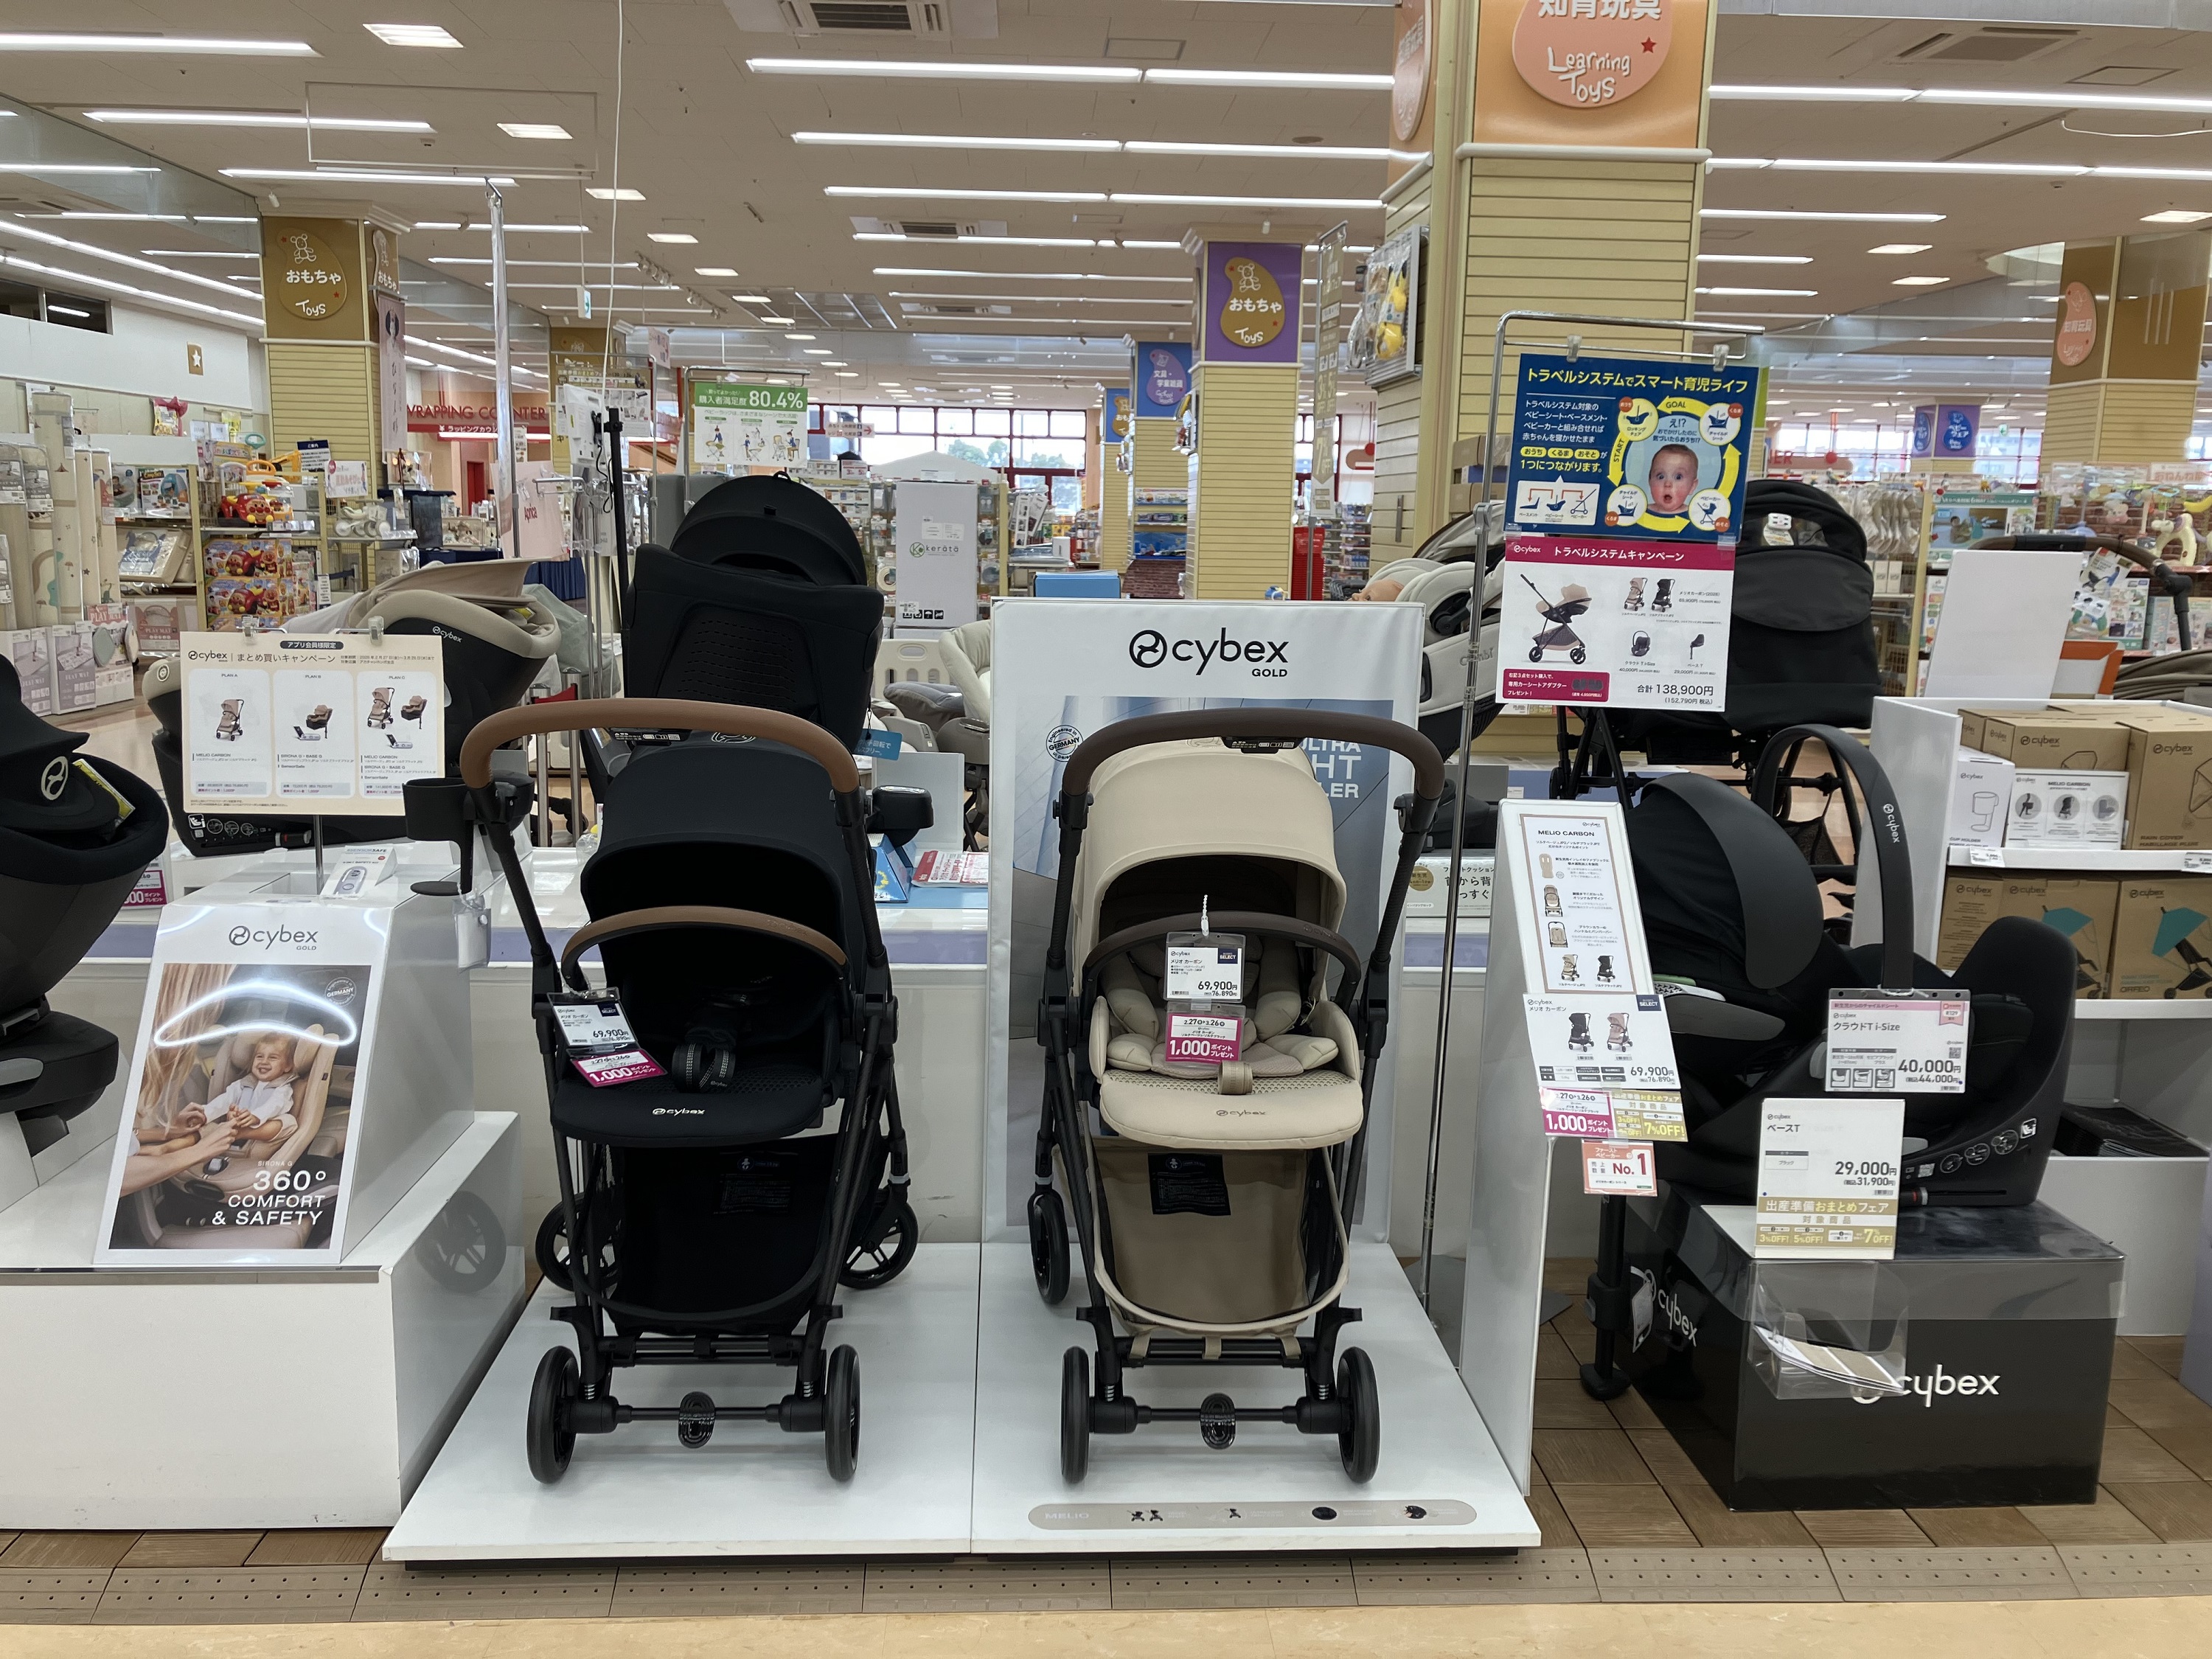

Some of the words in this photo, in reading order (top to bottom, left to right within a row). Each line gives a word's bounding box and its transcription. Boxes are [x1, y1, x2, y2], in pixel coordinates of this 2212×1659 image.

[1548, 47, 1630, 75] Learning
[1559, 69, 1615, 102] Toys
[286, 270, 341, 285] おもちゃ
[378, 270, 397, 291] おもちゃ
[296, 299, 326, 316] Toys
[1229, 297, 1281, 313] おもちゃ
[1234, 327, 1264, 344] Toys
[1528, 368, 1748, 393] トラベルシステムでスマート育児ライフ
[749, 390, 804, 408] 80.4%
[1525, 400, 1599, 411] トラベルシステム対象の
[479, 406, 546, 420] CONTER
[1523, 422, 1604, 433] ベビーカーと組み合せれば
[1669, 418, 1686, 428] え!?
[1523, 432, 1595, 443] 赤ちゃんを寝かせたまま
[1614, 439, 1624, 462] START
[1521, 459, 1603, 473] 1つにつながります。
[1521, 546, 1541, 554] cybex
[1554, 546, 1685, 562] トラベルシステムキャンペーン
[90, 611, 107, 622] PLAY
[440, 629, 462, 642] cybex
[199, 650, 228, 661] cybex
[237, 654, 335, 663] まとめ買いキャンペーン
[1172, 627, 1289, 675] cybex
[1251, 668, 1288, 677] GOLD
[1638, 685, 1653, 694] 合計
[1656, 684, 1714, 696] 138,900円
[1049, 737, 1079, 751] GERMANY
[2032, 735, 2060, 746] cybex
[2164, 743, 2194, 755] cybex
[1885, 814, 1900, 843] cybex
[1966, 885, 1992, 895] cybex
[2020, 886, 2046, 896] cybex
[2140, 888, 2165, 899] cybex
[253, 925, 319, 950] cybex
[327, 987, 353, 997] GERMANY
[1197, 981, 1237, 990] 69,900円
[1834, 1023, 1872, 1031] クラウドT
[1875, 1022, 1900, 1031] i-Size
[1170, 1040, 1210, 1056] 1,000
[1630, 1067, 1674, 1077] 69,900円
[1899, 1060, 1961, 1074] 40,000円
[590, 1068, 633, 1082] 1,000
[667, 1108, 705, 1116] cybex
[1546, 1113, 1586, 1131] 1,000
[1644, 1121, 1685, 1136] 7%OFF!
[1835, 1161, 1897, 1176] 29,000円
[253, 1169, 326, 1191] 360°
[228, 1194, 325, 1208] COMFORT
[1766, 1200, 1889, 1213] 出産準備おまとめフェア
[212, 1211, 226, 1225] &
[236, 1211, 324, 1225] SAFETY
[1760, 1234, 1789, 1243] 3%OFF!
[1794, 1235, 1823, 1244] 5%OFF!
[1658, 1289, 1697, 1347] cybex
[1899, 1364, 2000, 1408] cybex
